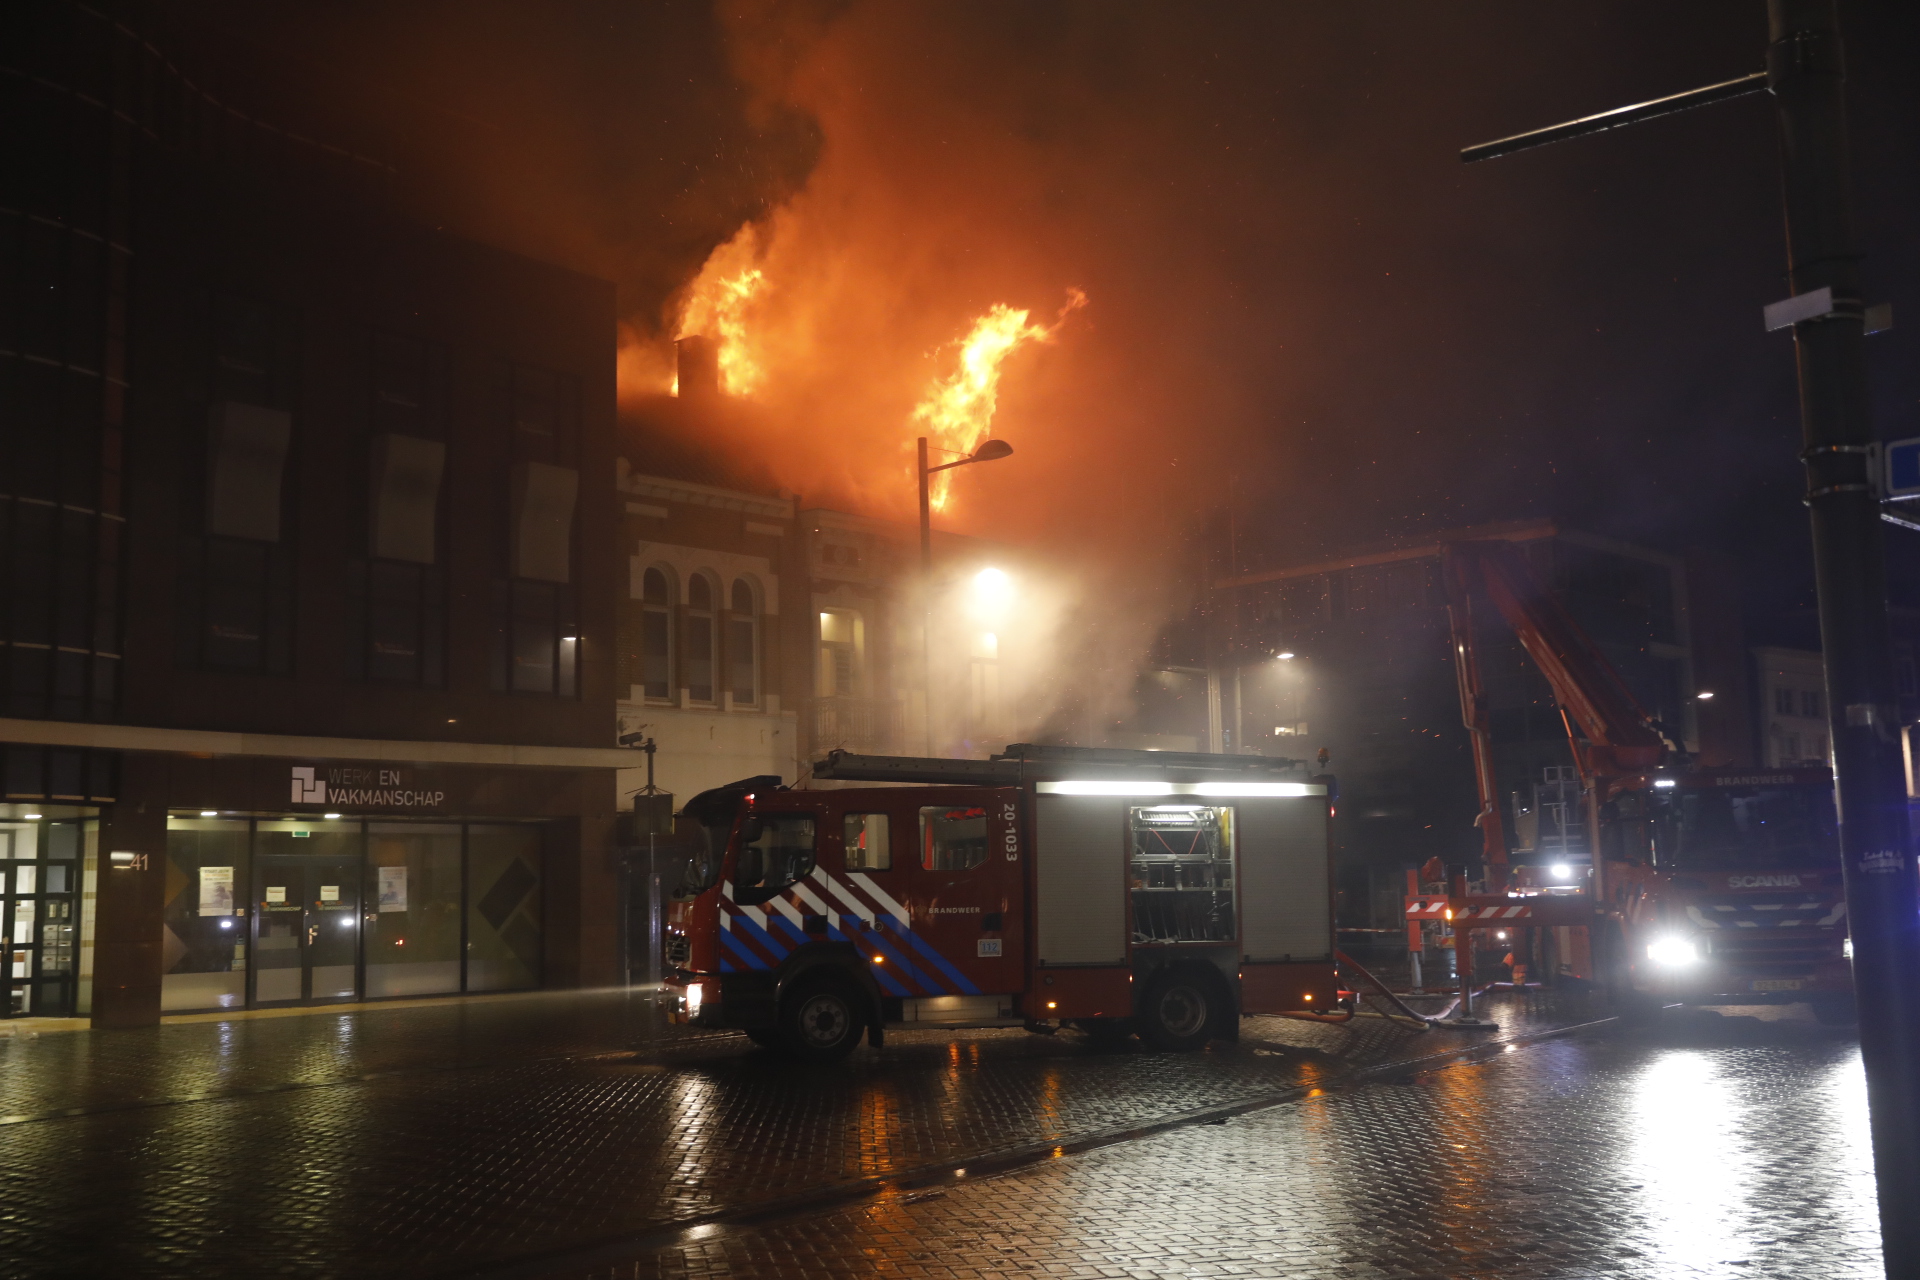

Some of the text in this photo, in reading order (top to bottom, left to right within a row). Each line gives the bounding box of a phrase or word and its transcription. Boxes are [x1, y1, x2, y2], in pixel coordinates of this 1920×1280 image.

[329, 768, 400, 786] WERK EN
[1716, 774, 1794, 786] BRANDWEER
[328, 788, 444, 807] VAKMANSCHAP
[1003, 803, 1018, 862] 20-1033
[129, 853, 148, 871] 41
[1728, 874, 1802, 890] SCANIA
[928, 906, 981, 914] BRANDWEER
[982, 943, 998, 952] 112
